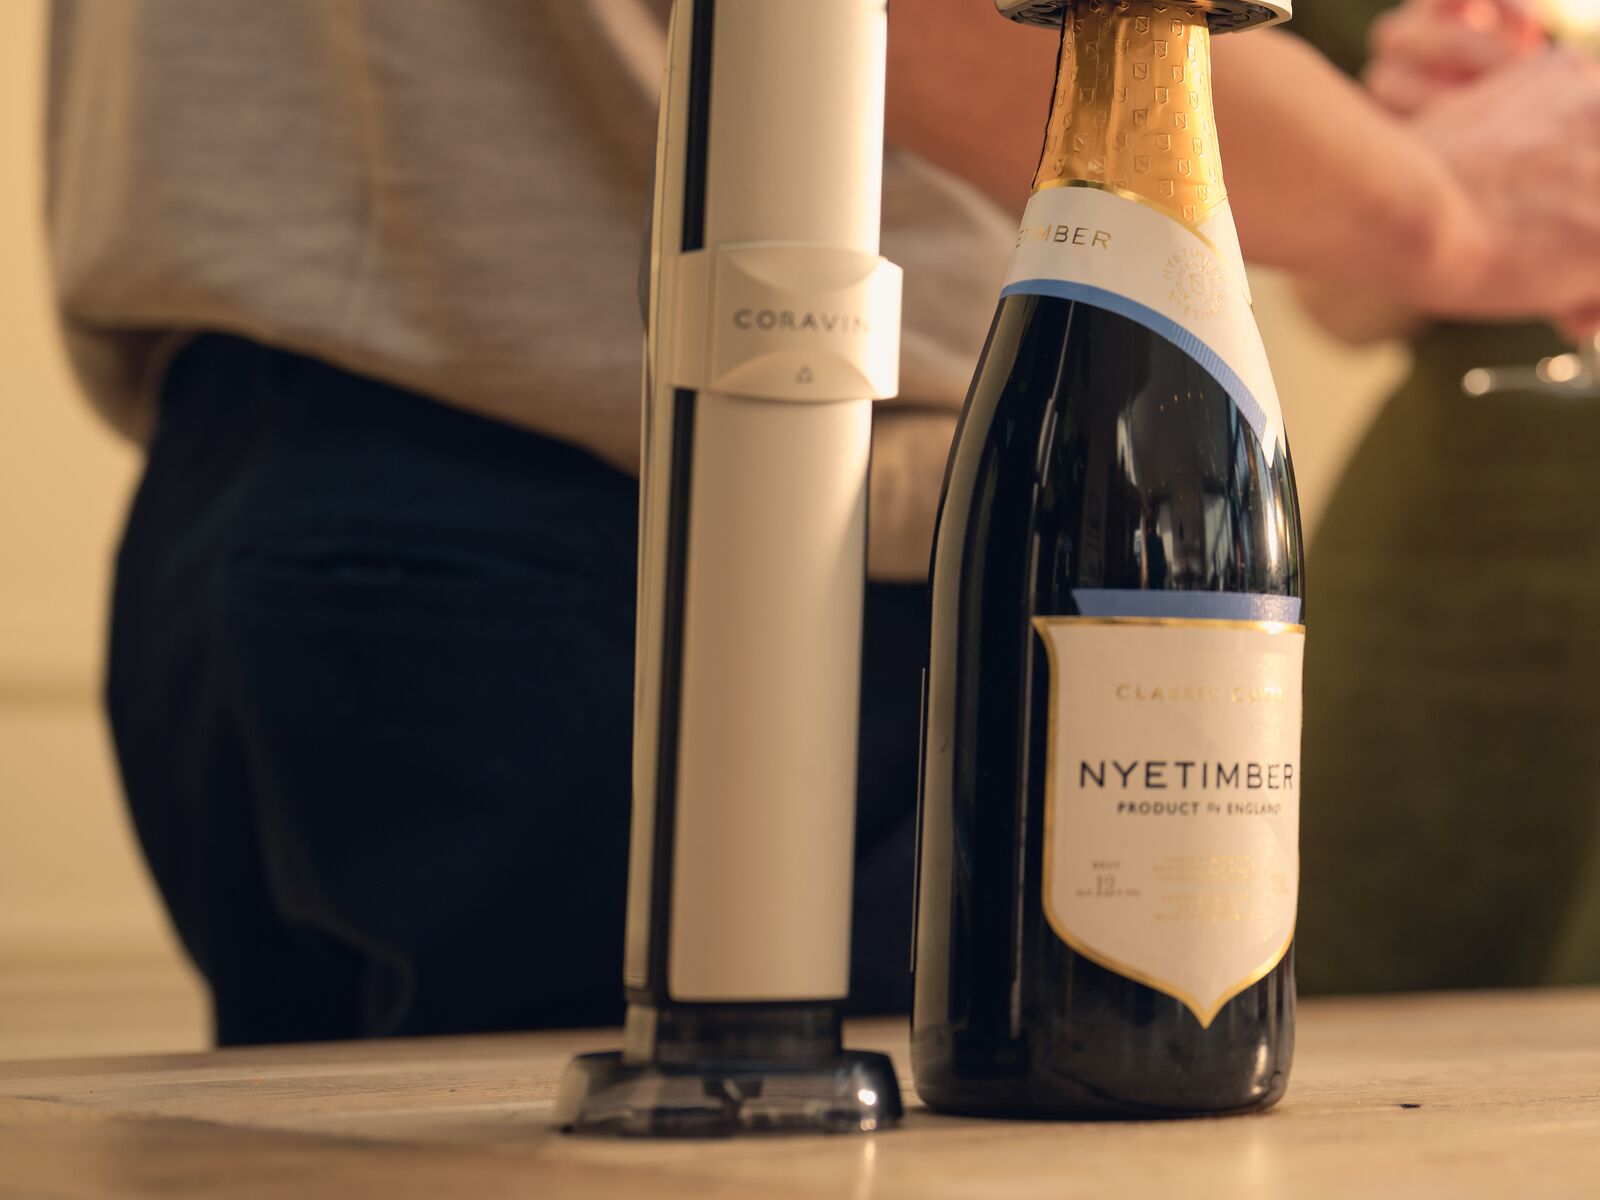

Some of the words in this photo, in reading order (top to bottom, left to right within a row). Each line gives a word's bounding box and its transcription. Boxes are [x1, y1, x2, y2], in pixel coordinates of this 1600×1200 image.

[732, 307, 869, 334] CORAVIN
[1079, 760, 1294, 790] NYETIMBER
[1116, 800, 1200, 817] PRODUCT
[1226, 800, 1282, 816] ENGLAND
